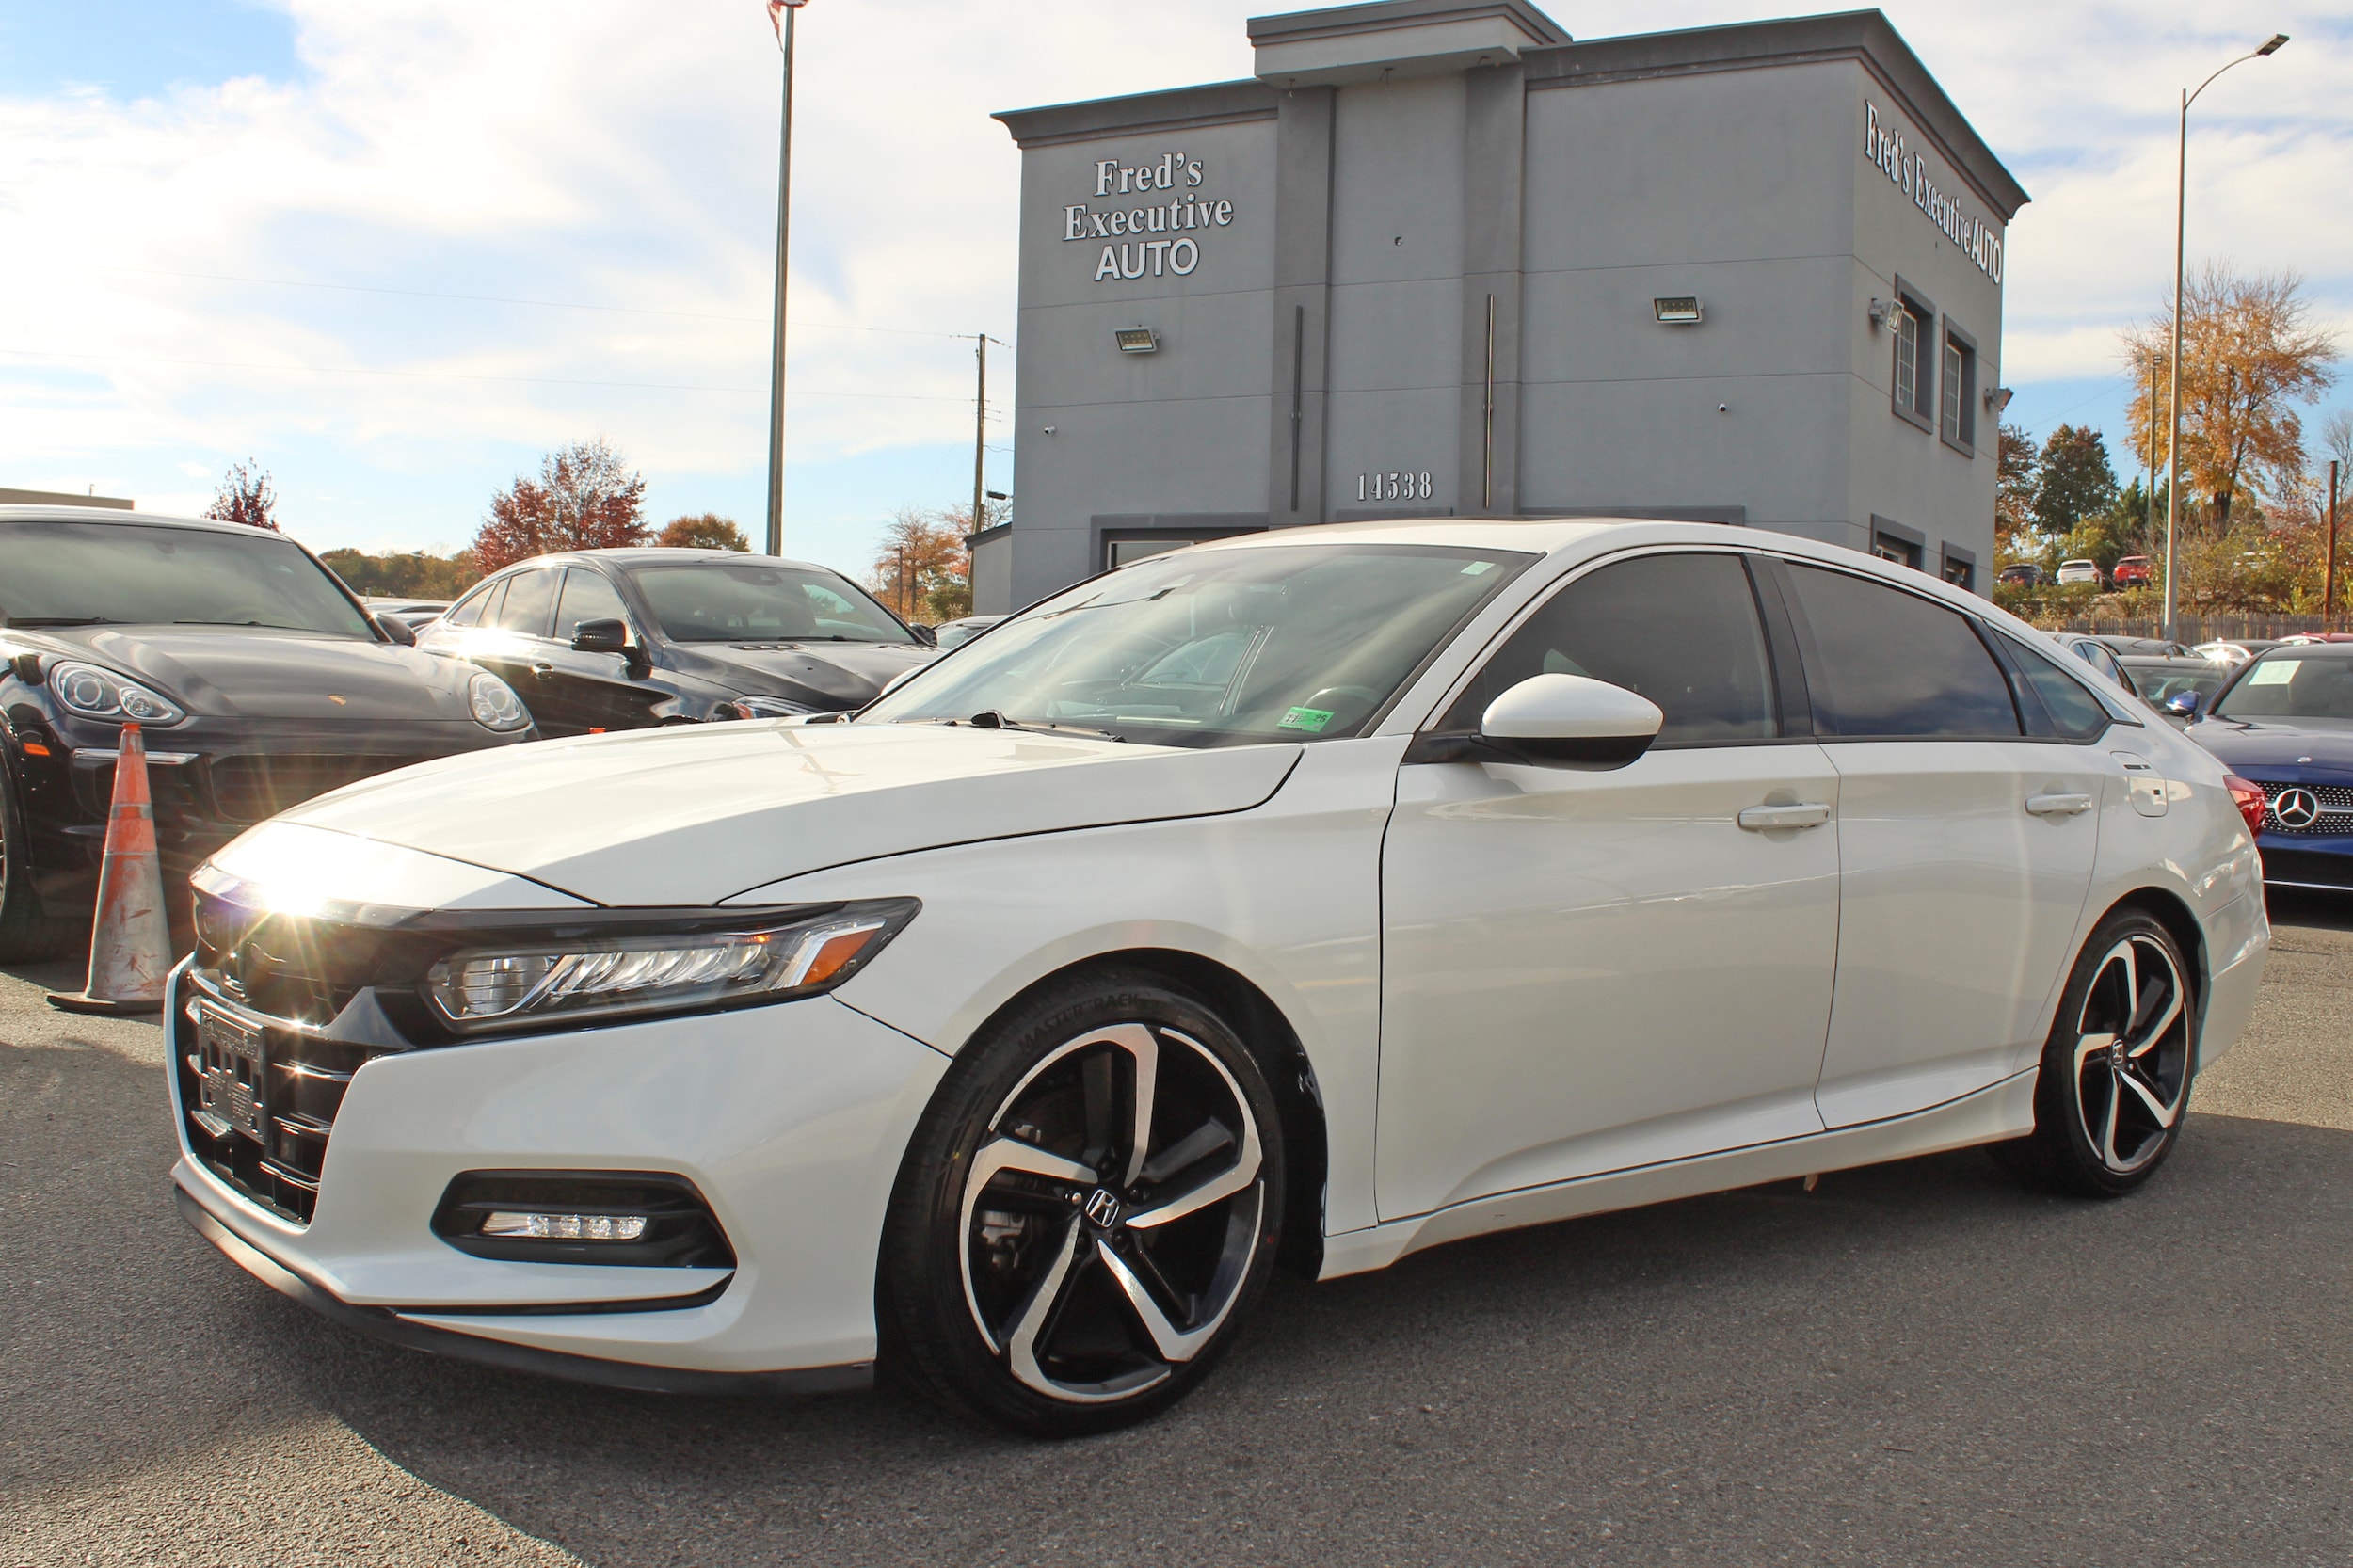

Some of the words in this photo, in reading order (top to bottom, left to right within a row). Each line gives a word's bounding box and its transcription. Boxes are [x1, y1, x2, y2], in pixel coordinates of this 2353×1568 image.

[1093, 152, 1204, 197] Fred's
[1865, 98, 1911, 195] Fred's
[1913, 152, 1971, 254] Executive
[1971, 216, 2003, 285] AUTO
[1063, 193, 1234, 241] Executive
[1094, 237, 1200, 281] AUTO
[1357, 472, 1433, 501] 14538
